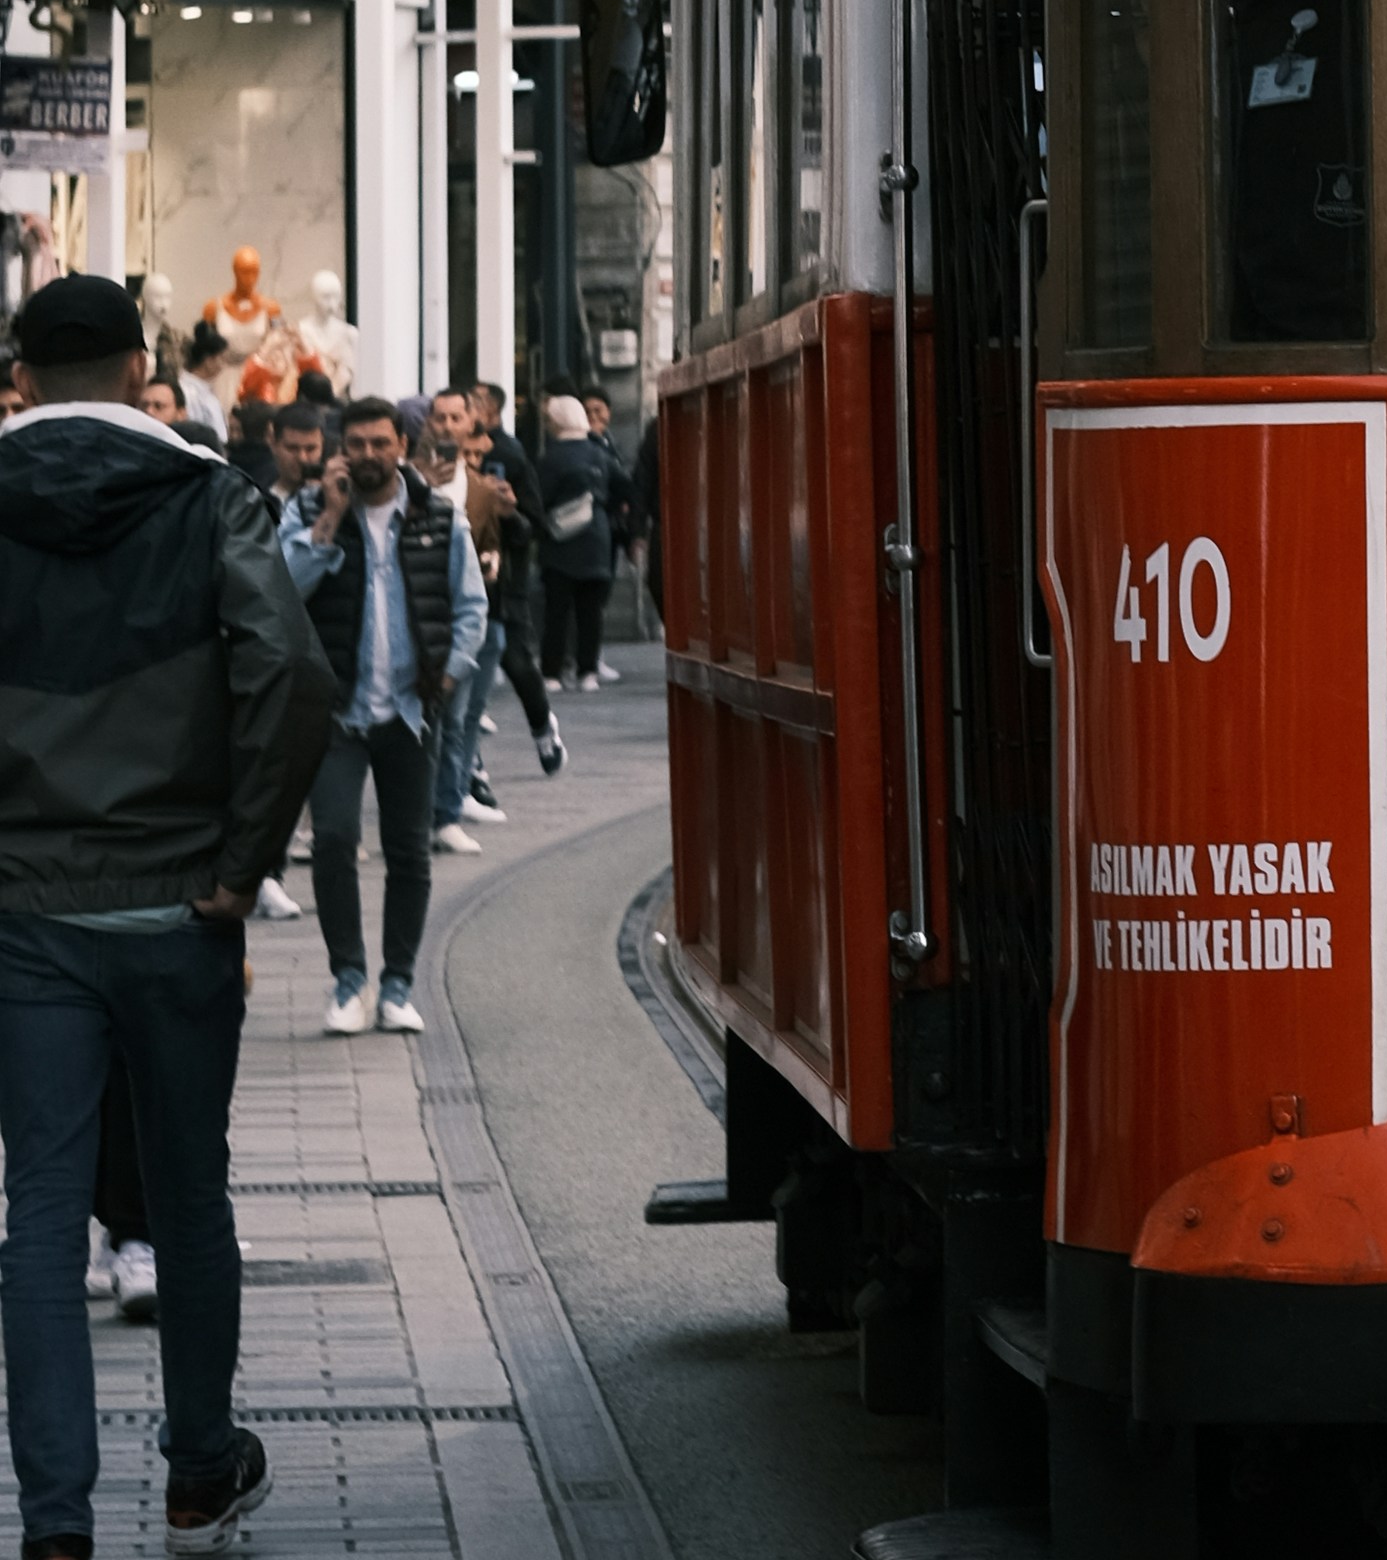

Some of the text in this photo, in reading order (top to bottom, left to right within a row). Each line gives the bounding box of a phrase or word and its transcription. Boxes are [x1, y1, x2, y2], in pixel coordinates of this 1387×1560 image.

[30, 99, 109, 130] BERBER
[1114, 536, 1231, 663] 410
[1090, 841, 1334, 897] ASILMAK YASAK
[1093, 907, 1332, 972] VE TEHLİKELİDİR
